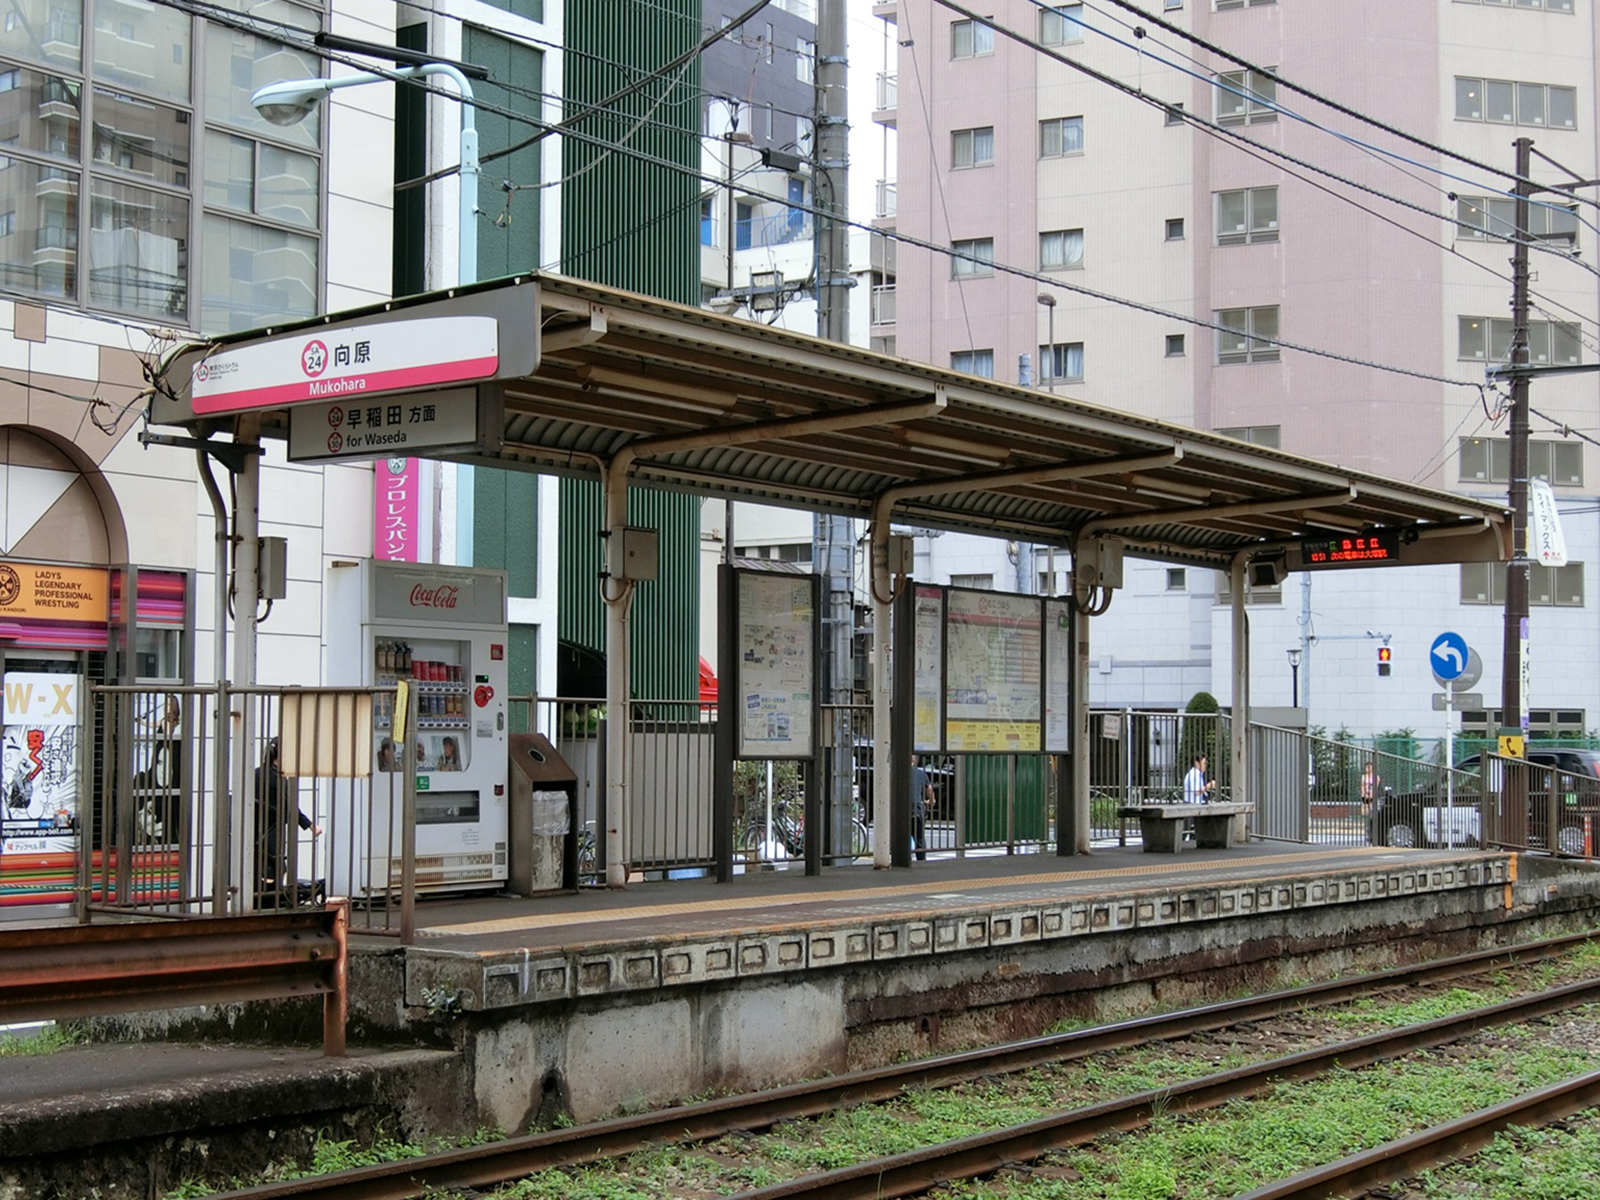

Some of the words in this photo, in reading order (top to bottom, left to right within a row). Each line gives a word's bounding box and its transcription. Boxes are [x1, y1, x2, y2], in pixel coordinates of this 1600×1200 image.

[311, 346, 320, 355] SA
[334, 340, 371, 367] 向原
[308, 356, 322, 370] 24
[309, 378, 366, 396] Mukohara
[347, 405, 402, 430] 早稲田
[408, 404, 436, 424] 方面
[331, 440, 340, 449] 30
[346, 434, 362, 448] for
[364, 429, 407, 446] Waseda
[34, 570, 62, 580] LADYS
[34, 580, 82, 591] LEGENDARY
[34, 589, 94, 601] PROFESSIONAL
[410, 583, 459, 609] Coca-Cola
[34, 598, 80, 609] WRESTLING
